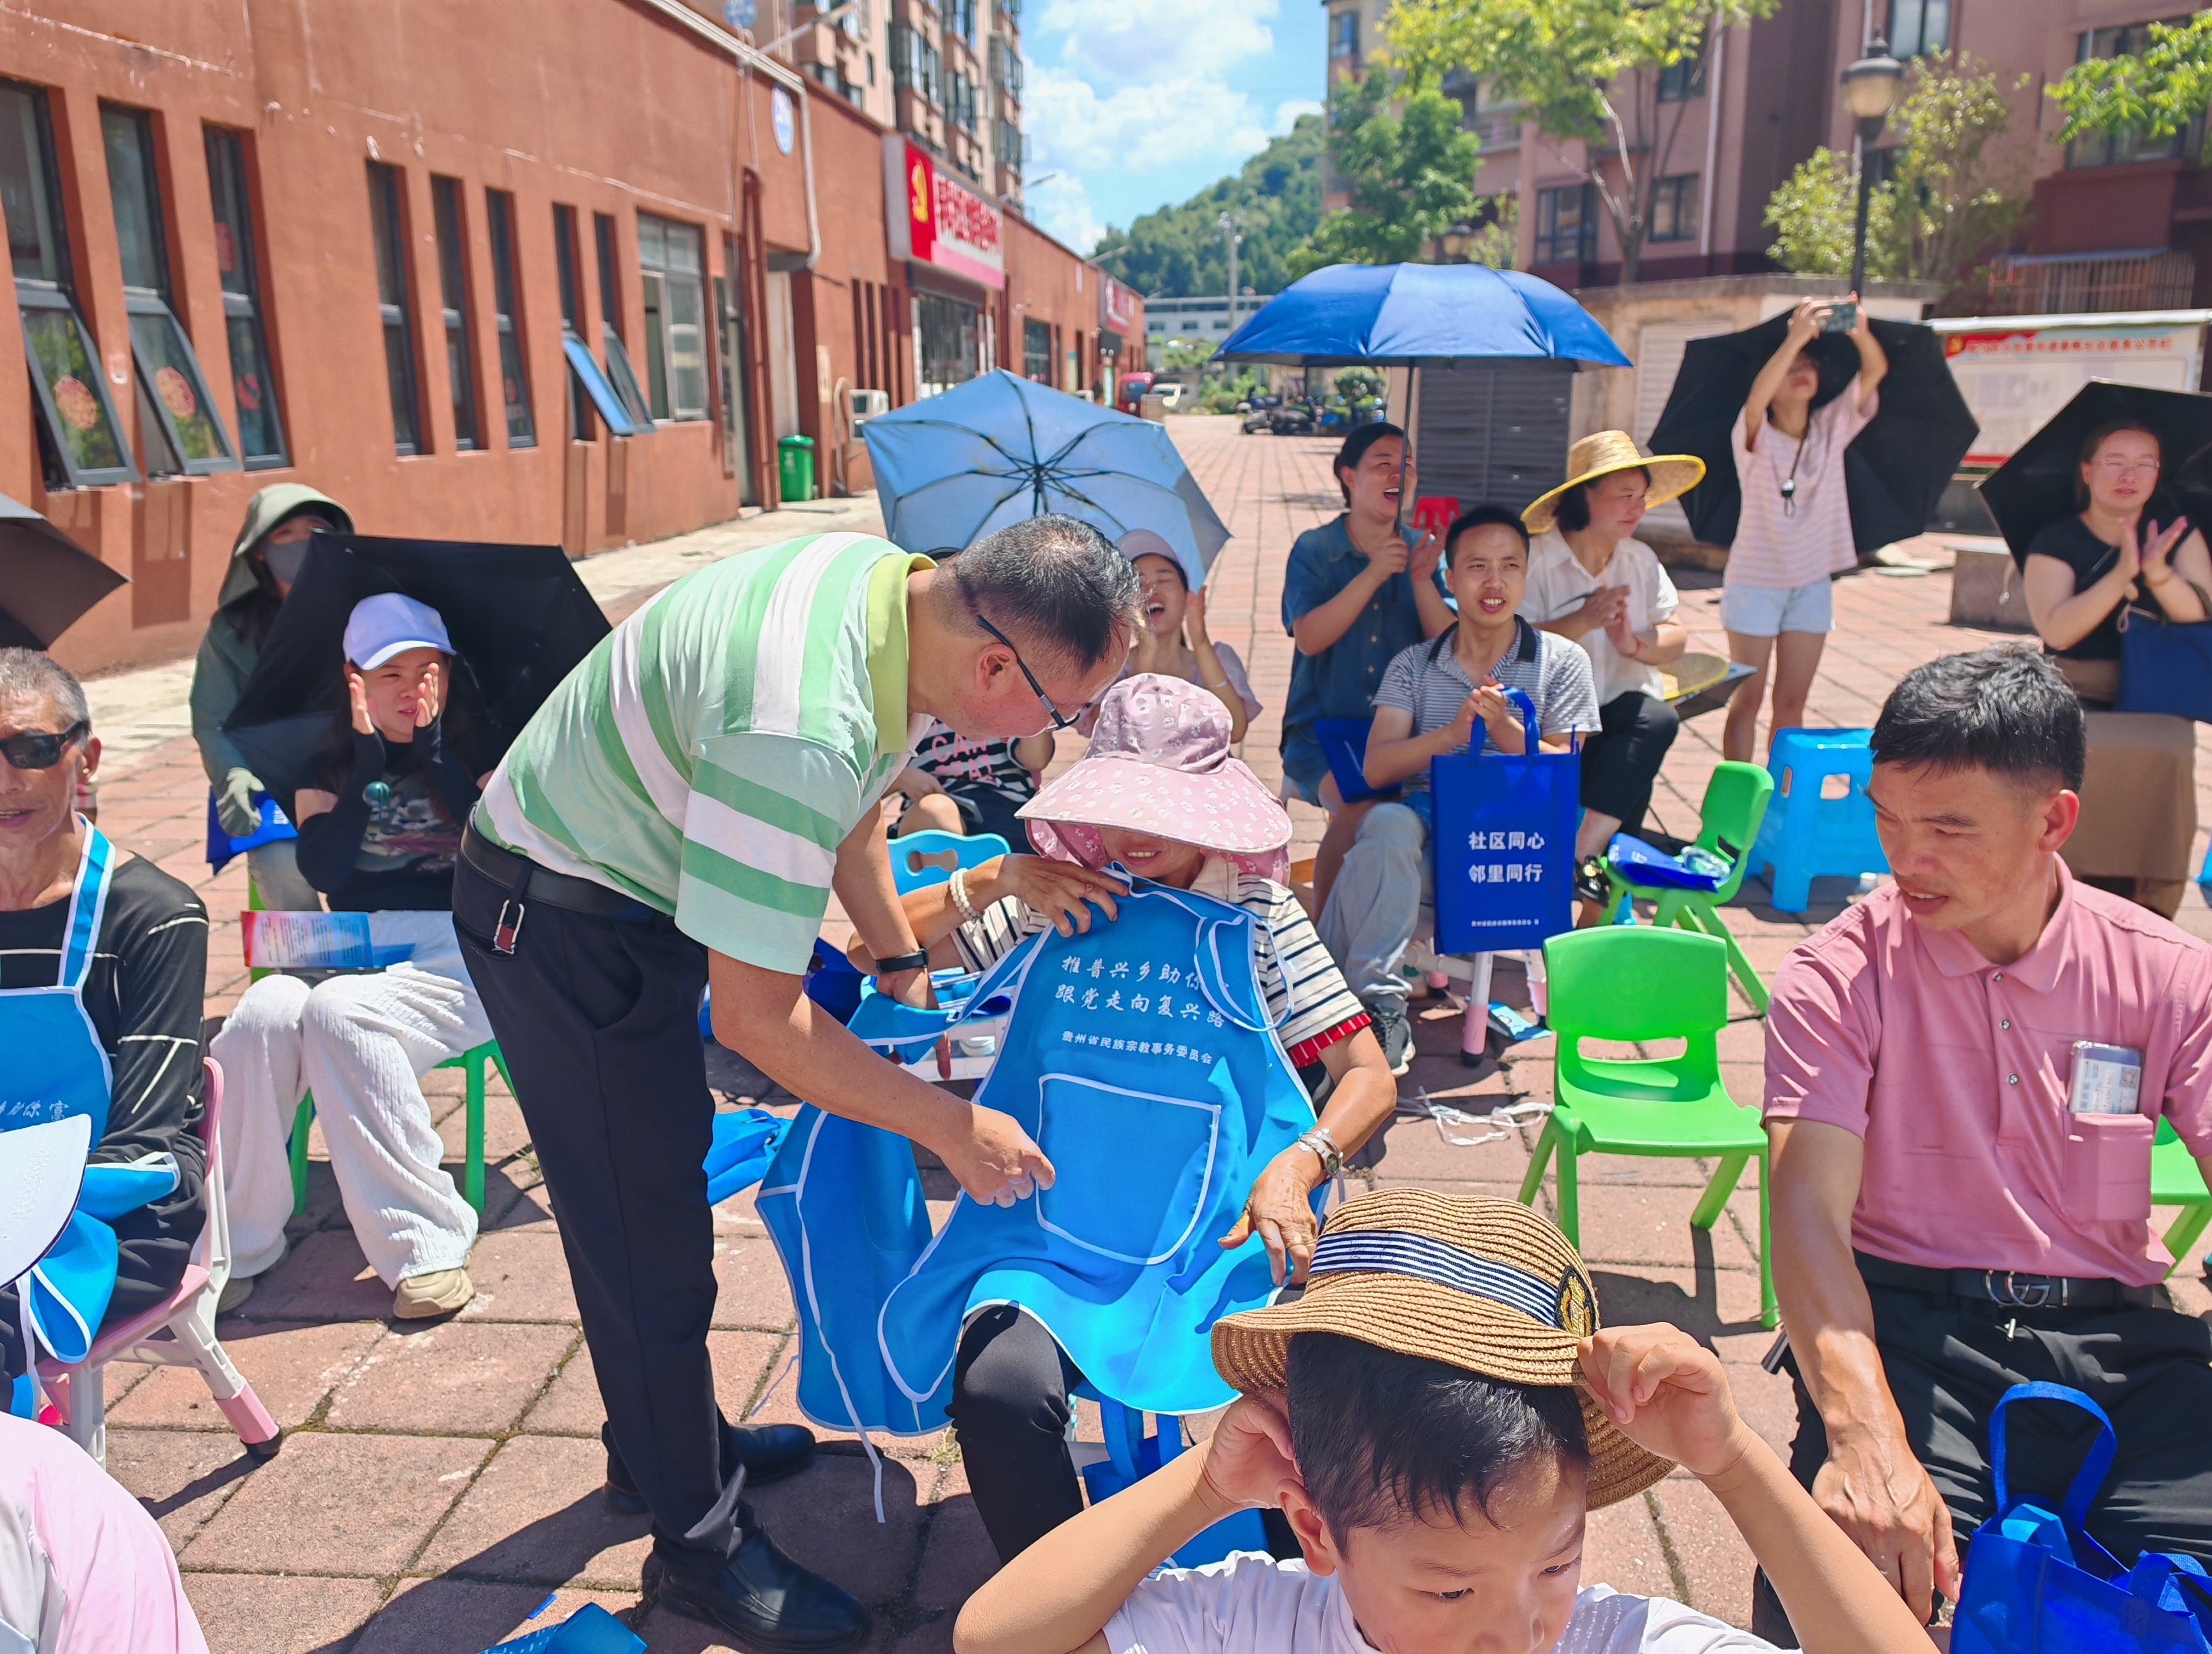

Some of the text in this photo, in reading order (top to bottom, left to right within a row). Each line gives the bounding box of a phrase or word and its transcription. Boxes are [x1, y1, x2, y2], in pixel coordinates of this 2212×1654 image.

[1468, 831, 1545, 850] 社区同心
[1468, 863, 1543, 883] 邻里同行
[1062, 955, 1229, 991] 推普兴乡助你
[1055, 984, 1225, 1028] 跟党走向复兴路
[1062, 1030, 1213, 1064] 贵州省民族宗教事务委员会
